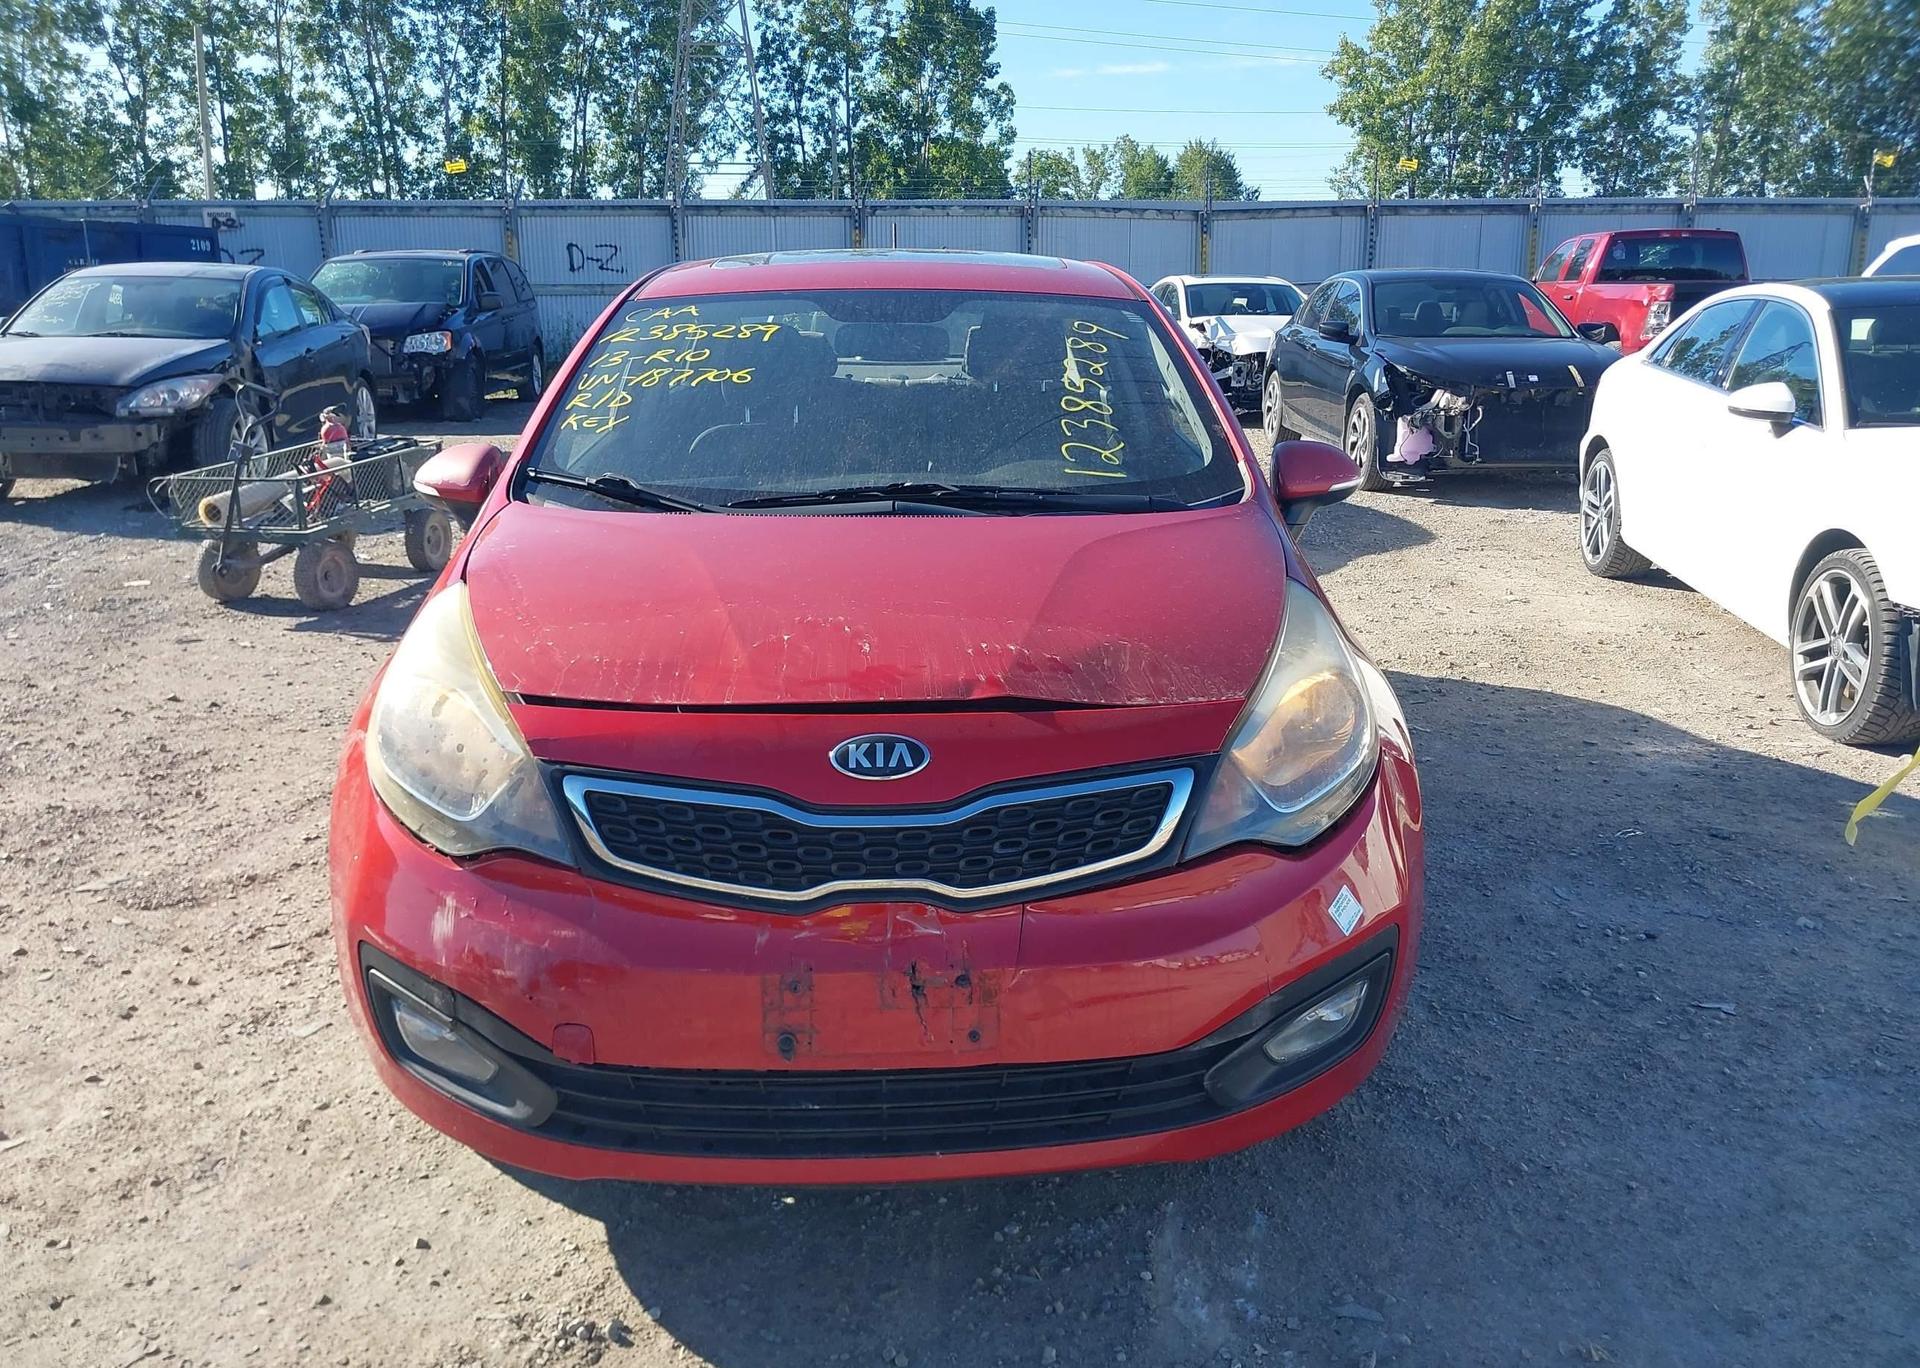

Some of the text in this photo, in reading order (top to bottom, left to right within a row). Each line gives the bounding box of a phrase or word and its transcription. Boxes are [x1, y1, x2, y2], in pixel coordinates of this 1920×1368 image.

[566, 242, 625, 273] D-2
[625, 305, 700, 323] CAA
[599, 323, 782, 344] 12385289
[1060, 321, 1130, 478] 12385289
[560, 413, 630, 434] KEY
[847, 742, 914, 769] KIA
